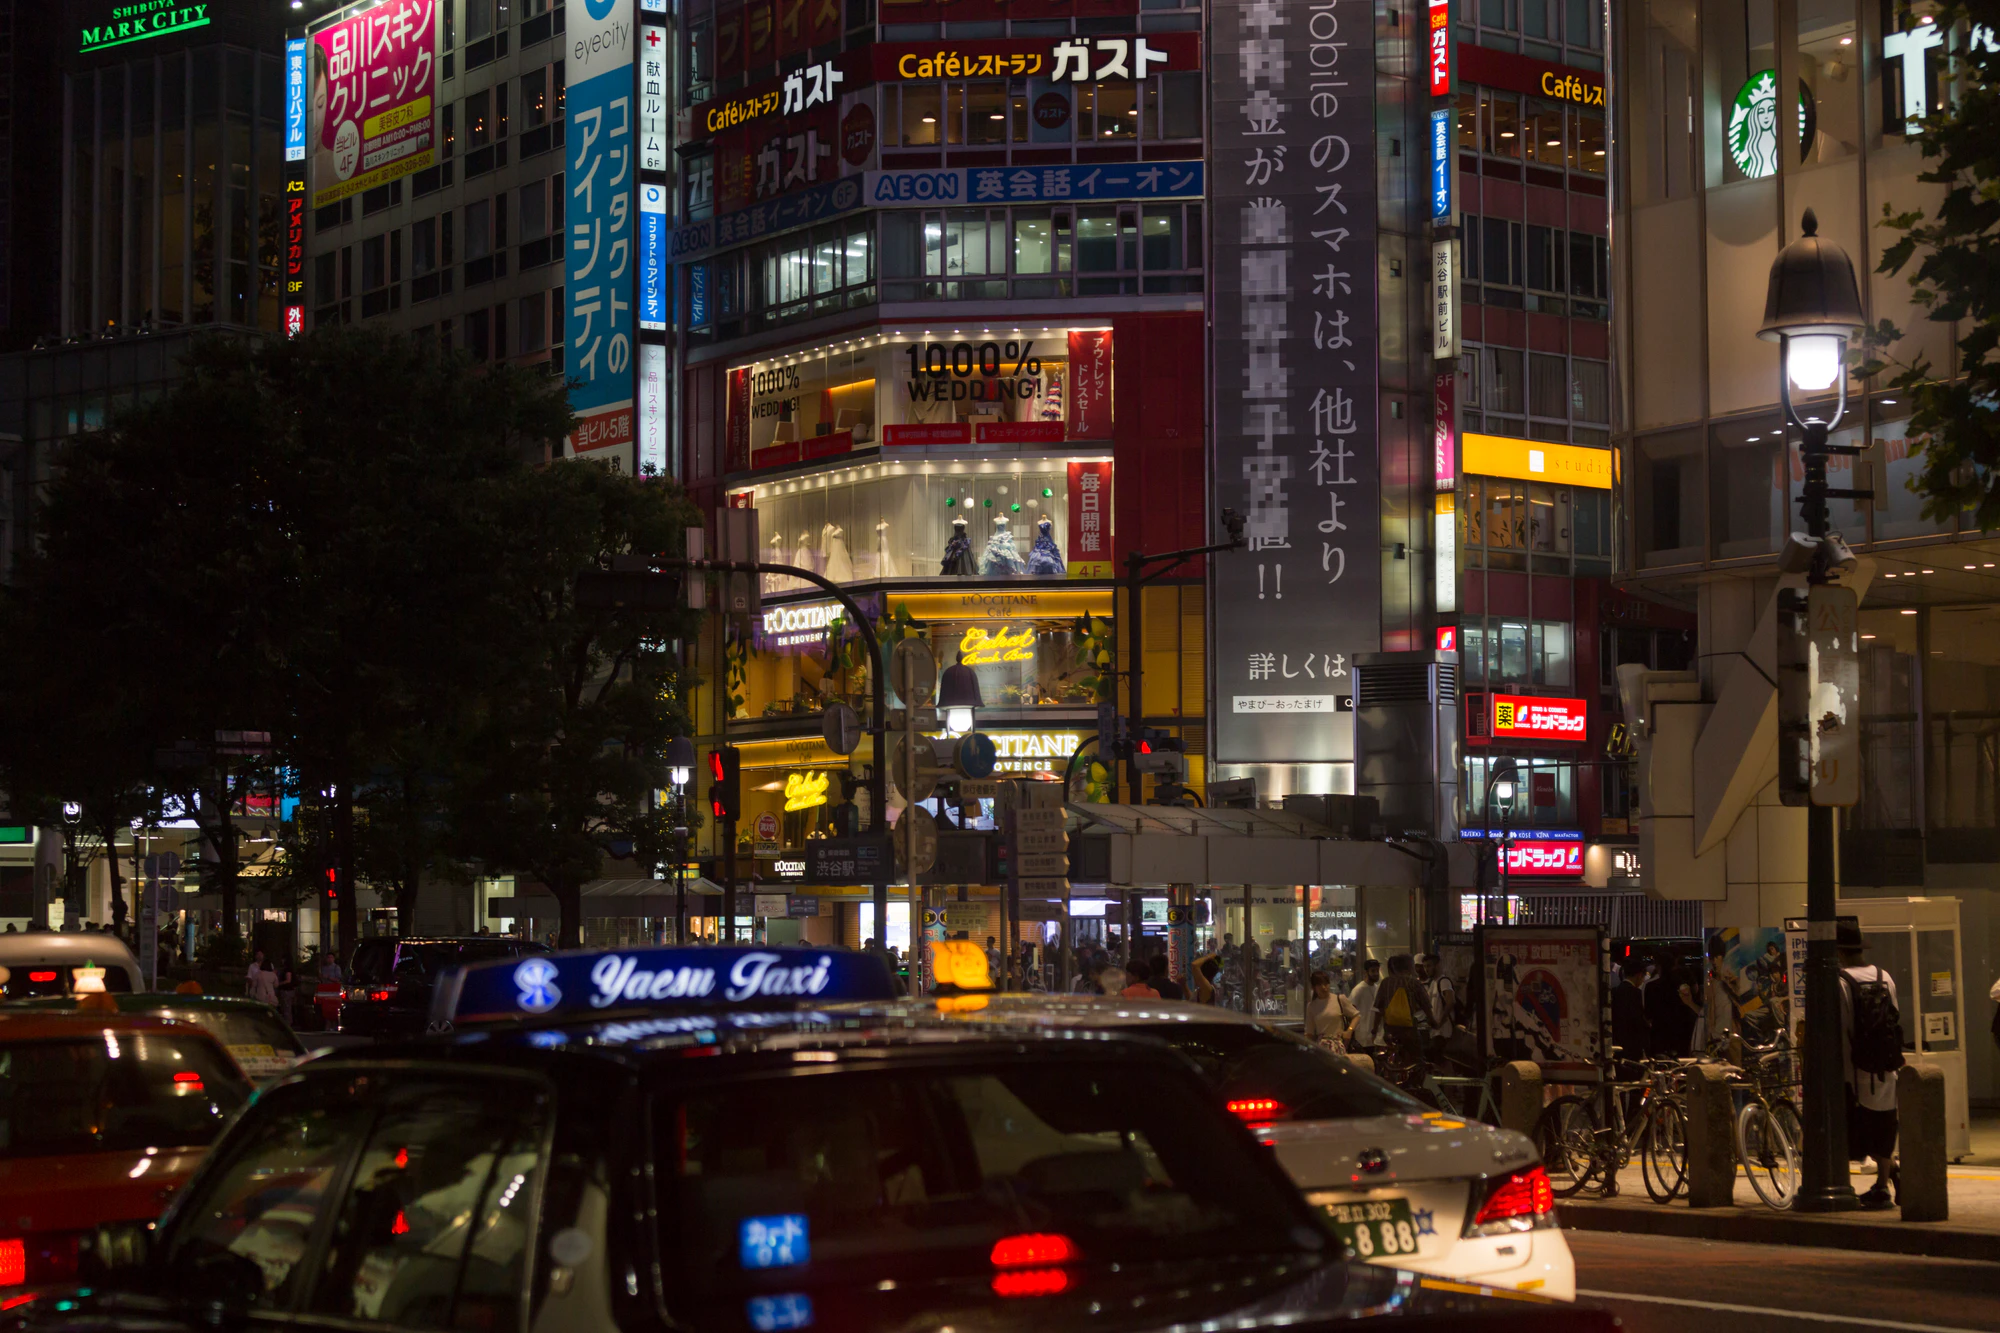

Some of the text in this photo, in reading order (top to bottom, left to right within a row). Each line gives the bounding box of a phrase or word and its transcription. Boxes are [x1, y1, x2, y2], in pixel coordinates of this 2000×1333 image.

[82, 4, 207, 45] MARK CITY
[113, 0, 175, 19] SHIBUYA
[330, 0, 432, 81] 品川スキン
[574, 20, 630, 65] eyecity
[1433, 27, 1446, 85] ガスト
[1052, 37, 1168, 83] ガスト
[290, 55, 302, 142] 東急リバブル
[330, 46, 431, 127] クリニック
[783, 60, 844, 116] ガスト
[645, 60, 661, 152] 献血ルーム
[1038, 106, 1067, 119] ガスト
[290, 149, 302, 159] 9F
[336, 131, 356, 154] 当ビル
[340, 154, 353, 174] 4F
[647, 158, 660, 167] 6F
[756, 135, 831, 199] ガスト
[1435, 121, 1447, 215] 英会話イーオン
[688, 168, 714, 207] 7F
[874, 172, 959, 201] AEON
[975, 166, 1196, 199] 英会話イーオン
[608, 95, 629, 374] コンタクトの
[719, 192, 827, 242] 英会話イーオン
[288, 198, 302, 275] アメリカン
[574, 106, 602, 381] アイシティ
[671, 222, 711, 257] AEON
[287, 281, 303, 292] 8F
[1437, 251, 1449, 349] 渋谷駅前ビル
[906, 340, 1042, 379] 1000%
[1092, 337, 1105, 401] アウトレット
[751, 365, 800, 398] 1000%
[907, 378, 1042, 402] WEDDING!
[1076, 364, 1090, 433] ドレスセール
[1436, 374, 1453, 387] 5F
[751, 395, 800, 419] WEDDING!
[578, 413, 631, 447] 当ビル5階
[1080, 471, 1101, 552] 毎日開催
[1078, 565, 1101, 577] 4F
[987, 607, 1012, 617] Café
[778, 637, 788, 646] EN
[1248, 652, 1347, 681] 詳しくは
[1498, 705, 1512, 726] 薬
[1531, 713, 1585, 731] サンドラッグ
[817, 860, 855, 877] 渋谷駅
[591, 952, 831, 1008] Yaesu Taxi
